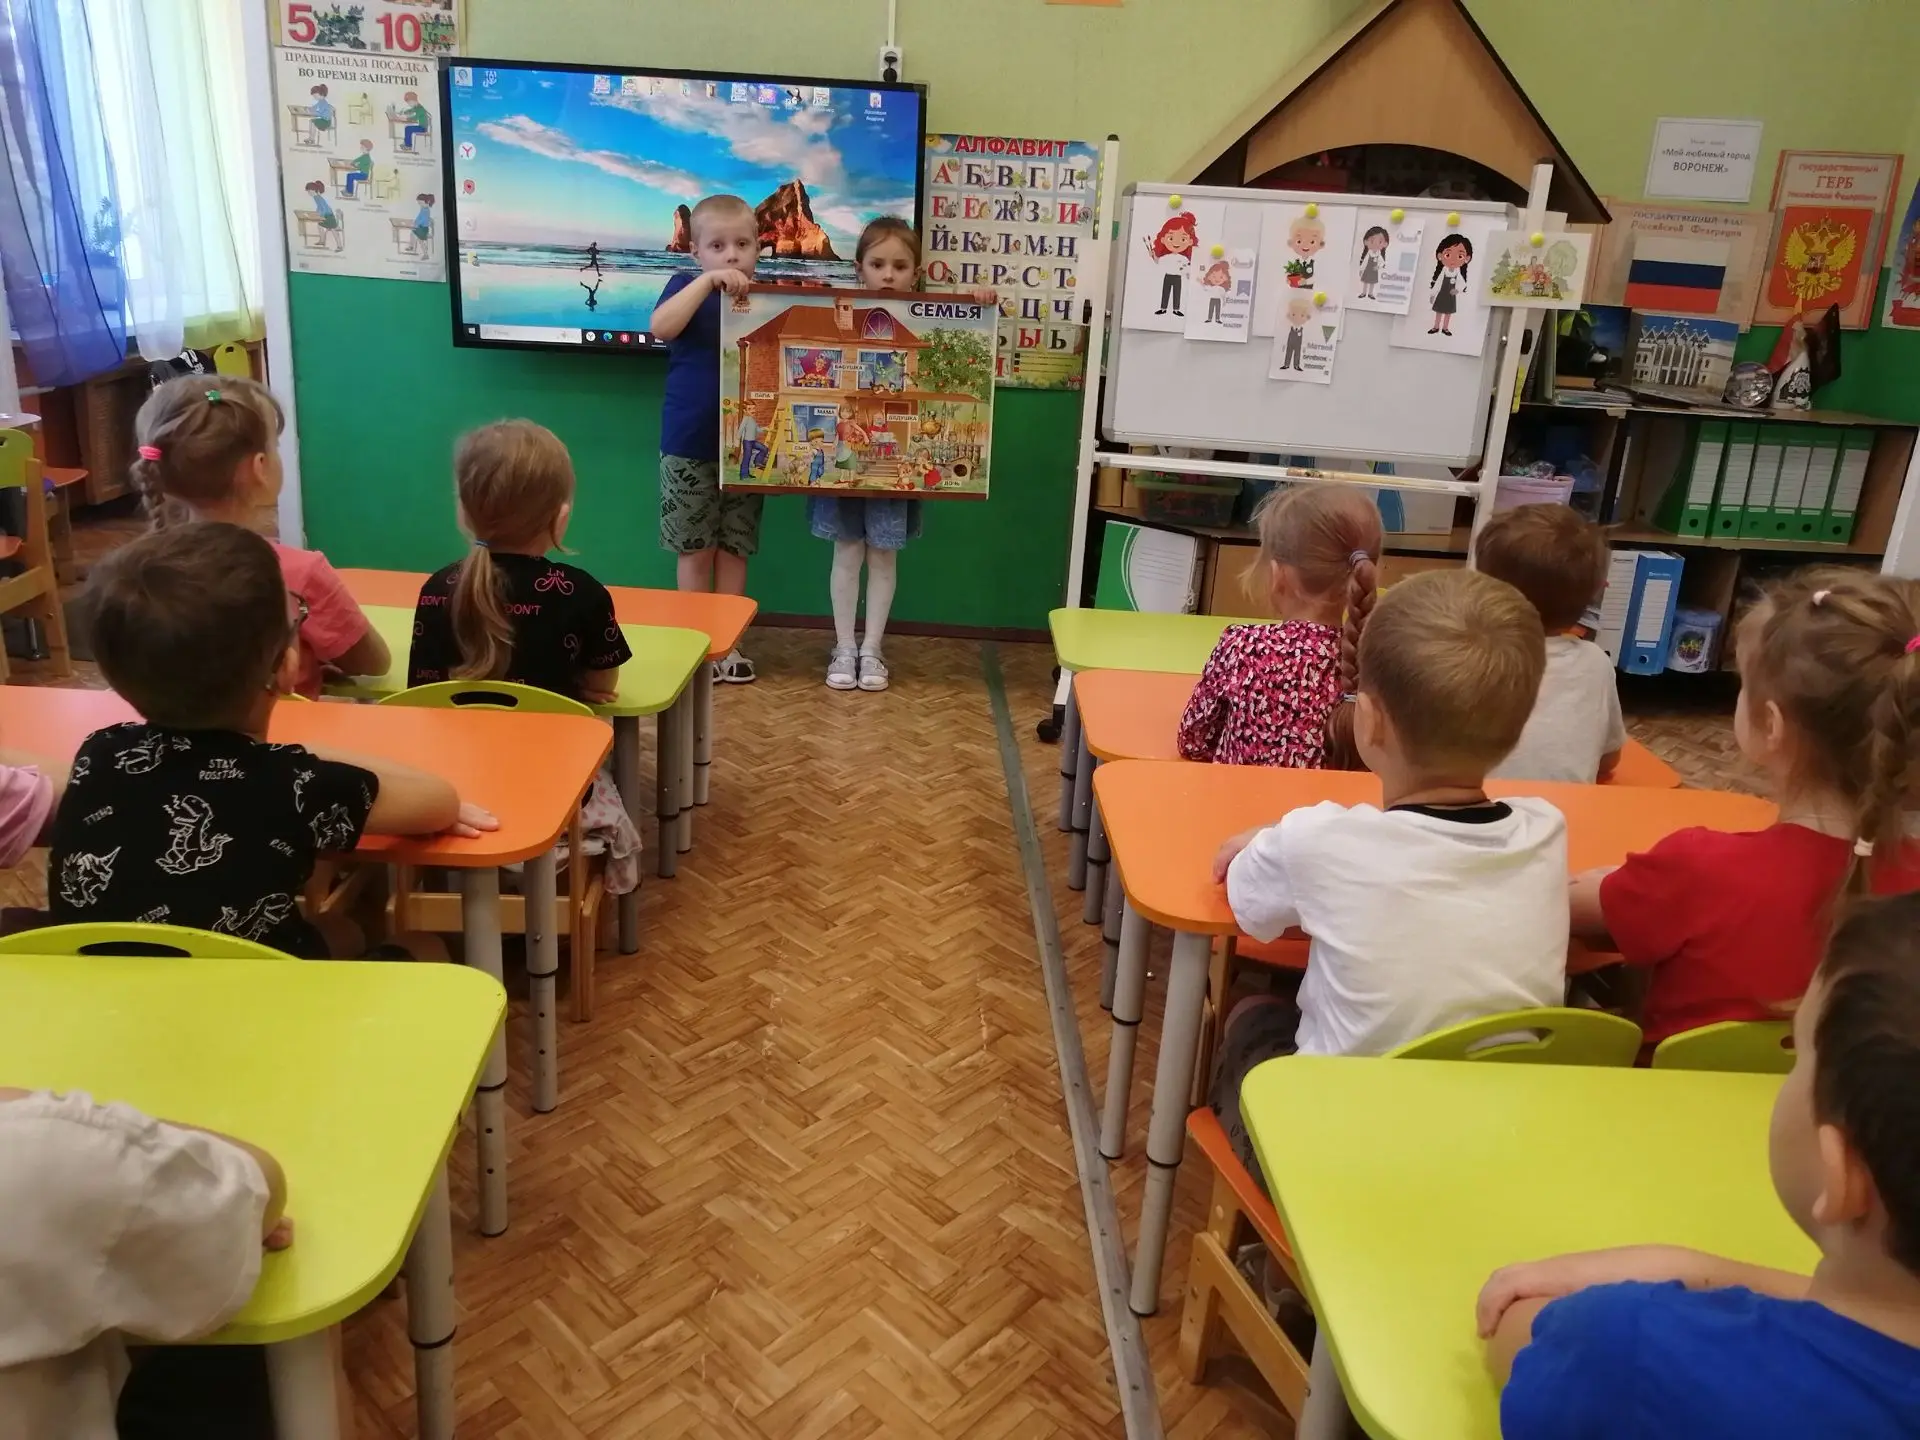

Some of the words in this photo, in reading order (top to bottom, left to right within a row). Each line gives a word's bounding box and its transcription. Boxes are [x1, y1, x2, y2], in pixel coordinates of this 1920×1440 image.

[288, 4, 317, 43] 5
[376, 13, 422, 53] 10
[285, 52, 368, 69] ПРАВИЛЬНАЯ
[371, 60, 430, 73] ПОСАДКА
[298, 68, 315, 78] ВО
[317, 69, 357, 81] ВРЕМЯ
[360, 73, 419, 87] ЗАНЯТИЙ
[955, 136, 1069, 158] АЛФАВИТ
[1816, 176, 1855, 190] ГЕРБ
[909, 302, 983, 321] СЕМЬЯ
[208, 758, 239, 769] STAY
[198, 768, 246, 781] POSITIVE
